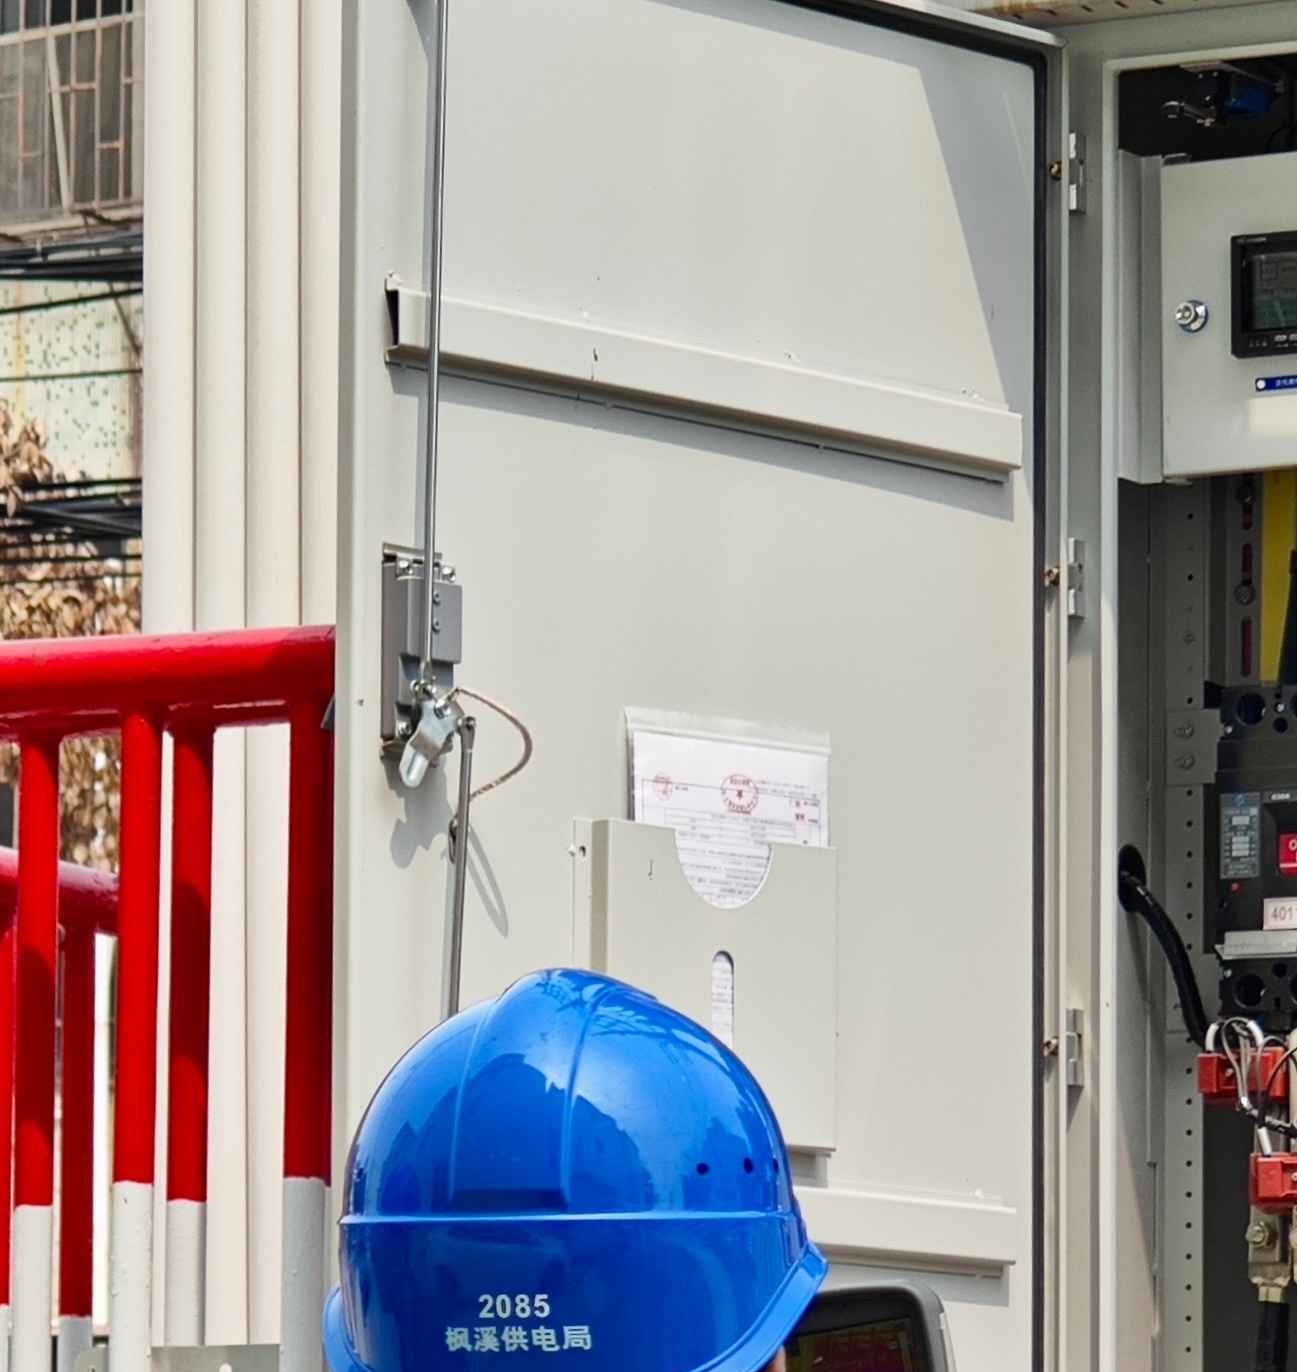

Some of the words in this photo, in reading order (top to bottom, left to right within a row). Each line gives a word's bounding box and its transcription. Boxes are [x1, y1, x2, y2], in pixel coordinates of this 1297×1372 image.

[477, 1293, 551, 1319] 2085
[444, 1324, 593, 1353] 枫溪供电局
